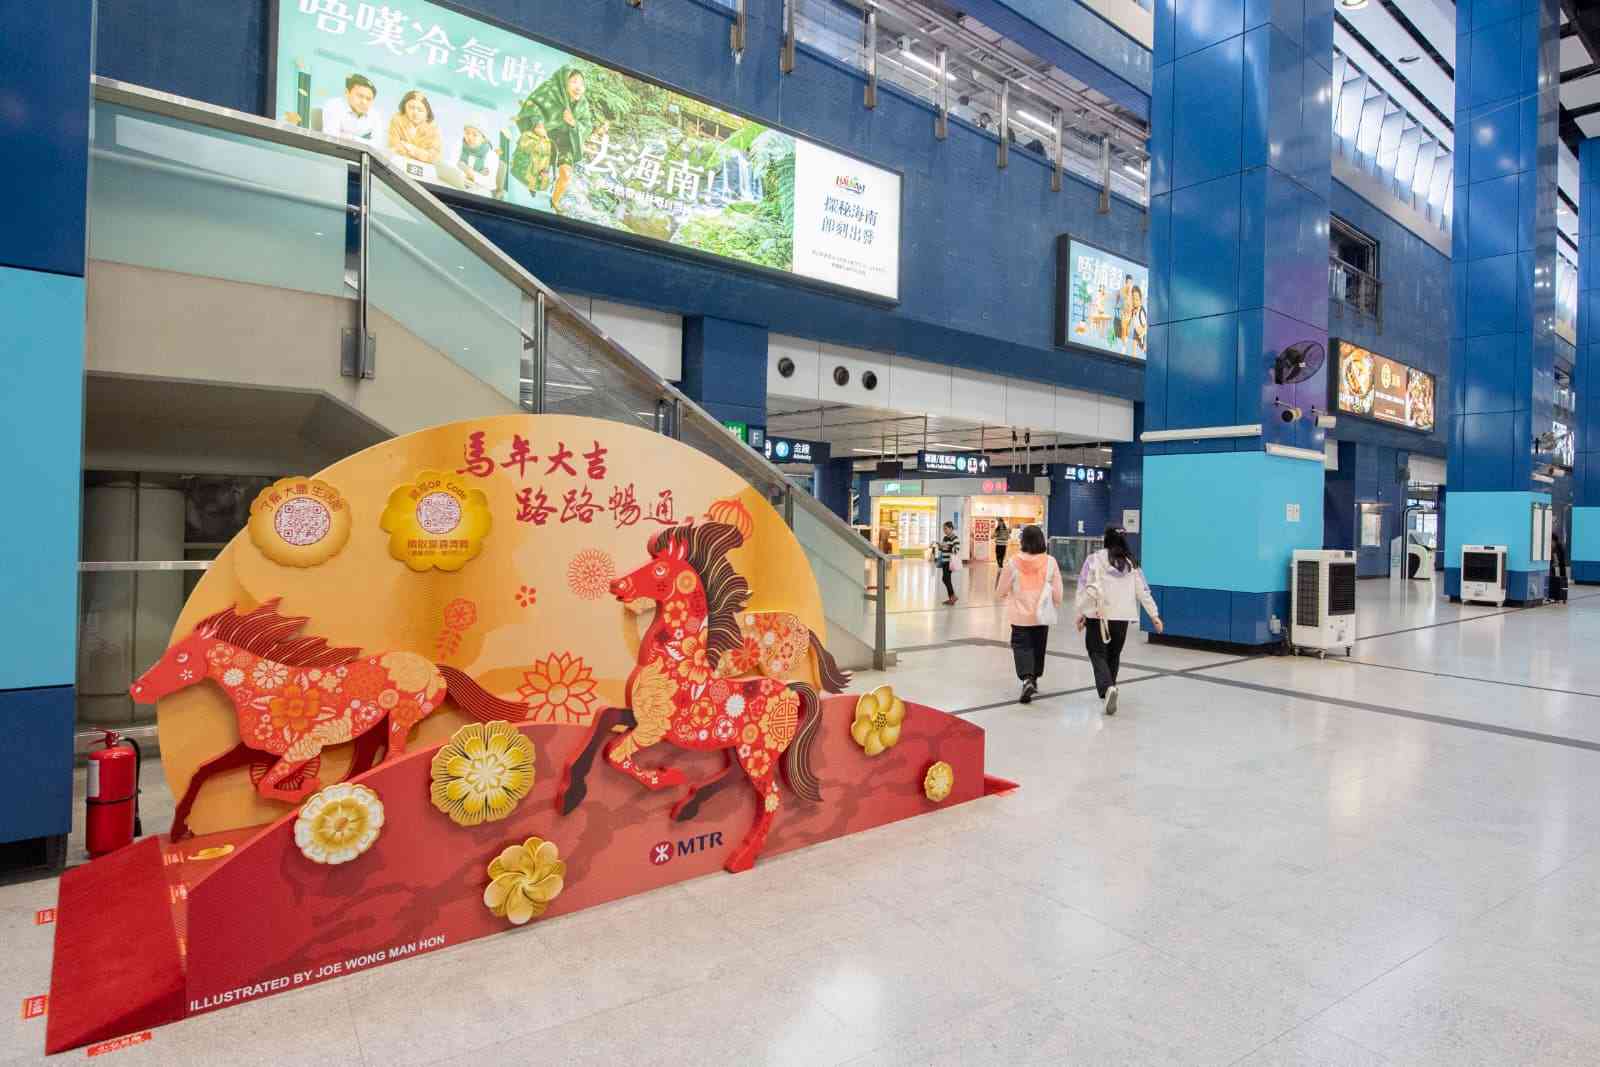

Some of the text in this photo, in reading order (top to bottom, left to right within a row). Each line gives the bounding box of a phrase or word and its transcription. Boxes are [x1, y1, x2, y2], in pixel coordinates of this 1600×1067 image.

[455, 431, 608, 480] 馬年大吉
[514, 482, 680, 529] 路路暢通
[677, 831, 723, 857] MTR
[189, 934, 446, 1012] ILLUSTRATED BY JOE WONG MAN HON
